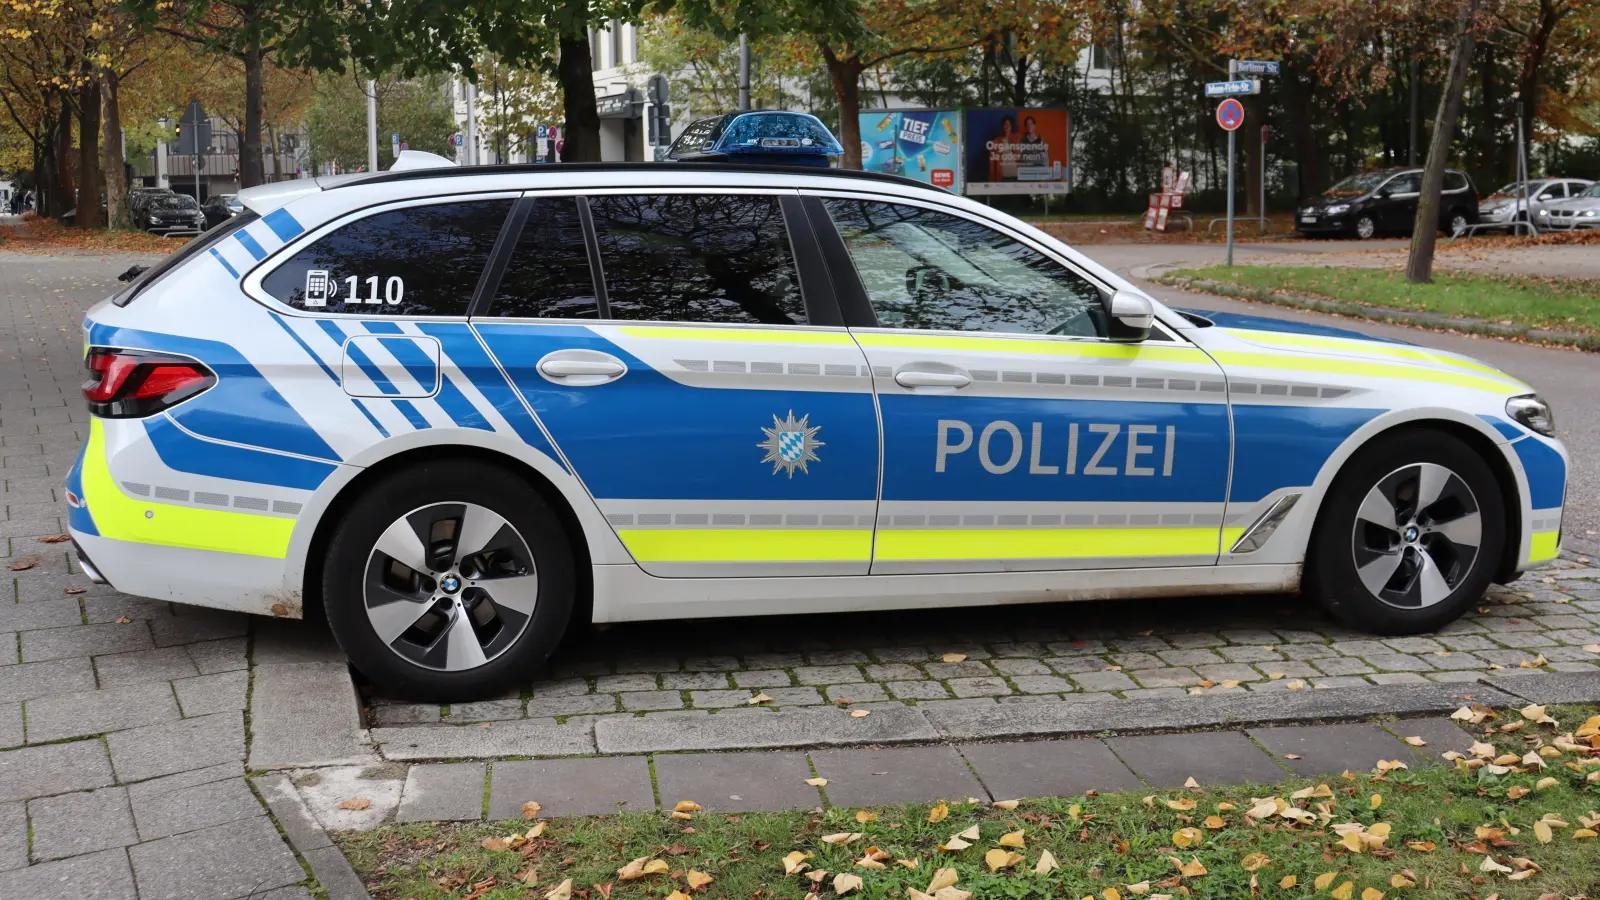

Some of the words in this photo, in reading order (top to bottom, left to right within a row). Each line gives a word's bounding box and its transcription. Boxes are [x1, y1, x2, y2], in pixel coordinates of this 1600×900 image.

[1238, 62, 1265, 73] Berliner
[903, 117, 930, 134] TIEF
[902, 131, 923, 143] PREIS
[985, 140, 1049, 153] Organspende
[990, 151, 1000, 161] Ja
[1001, 151, 1021, 161] oder
[1022, 152, 1045, 161] nein?
[344, 275, 404, 305] 110
[935, 419, 1176, 477] POLIZEI
